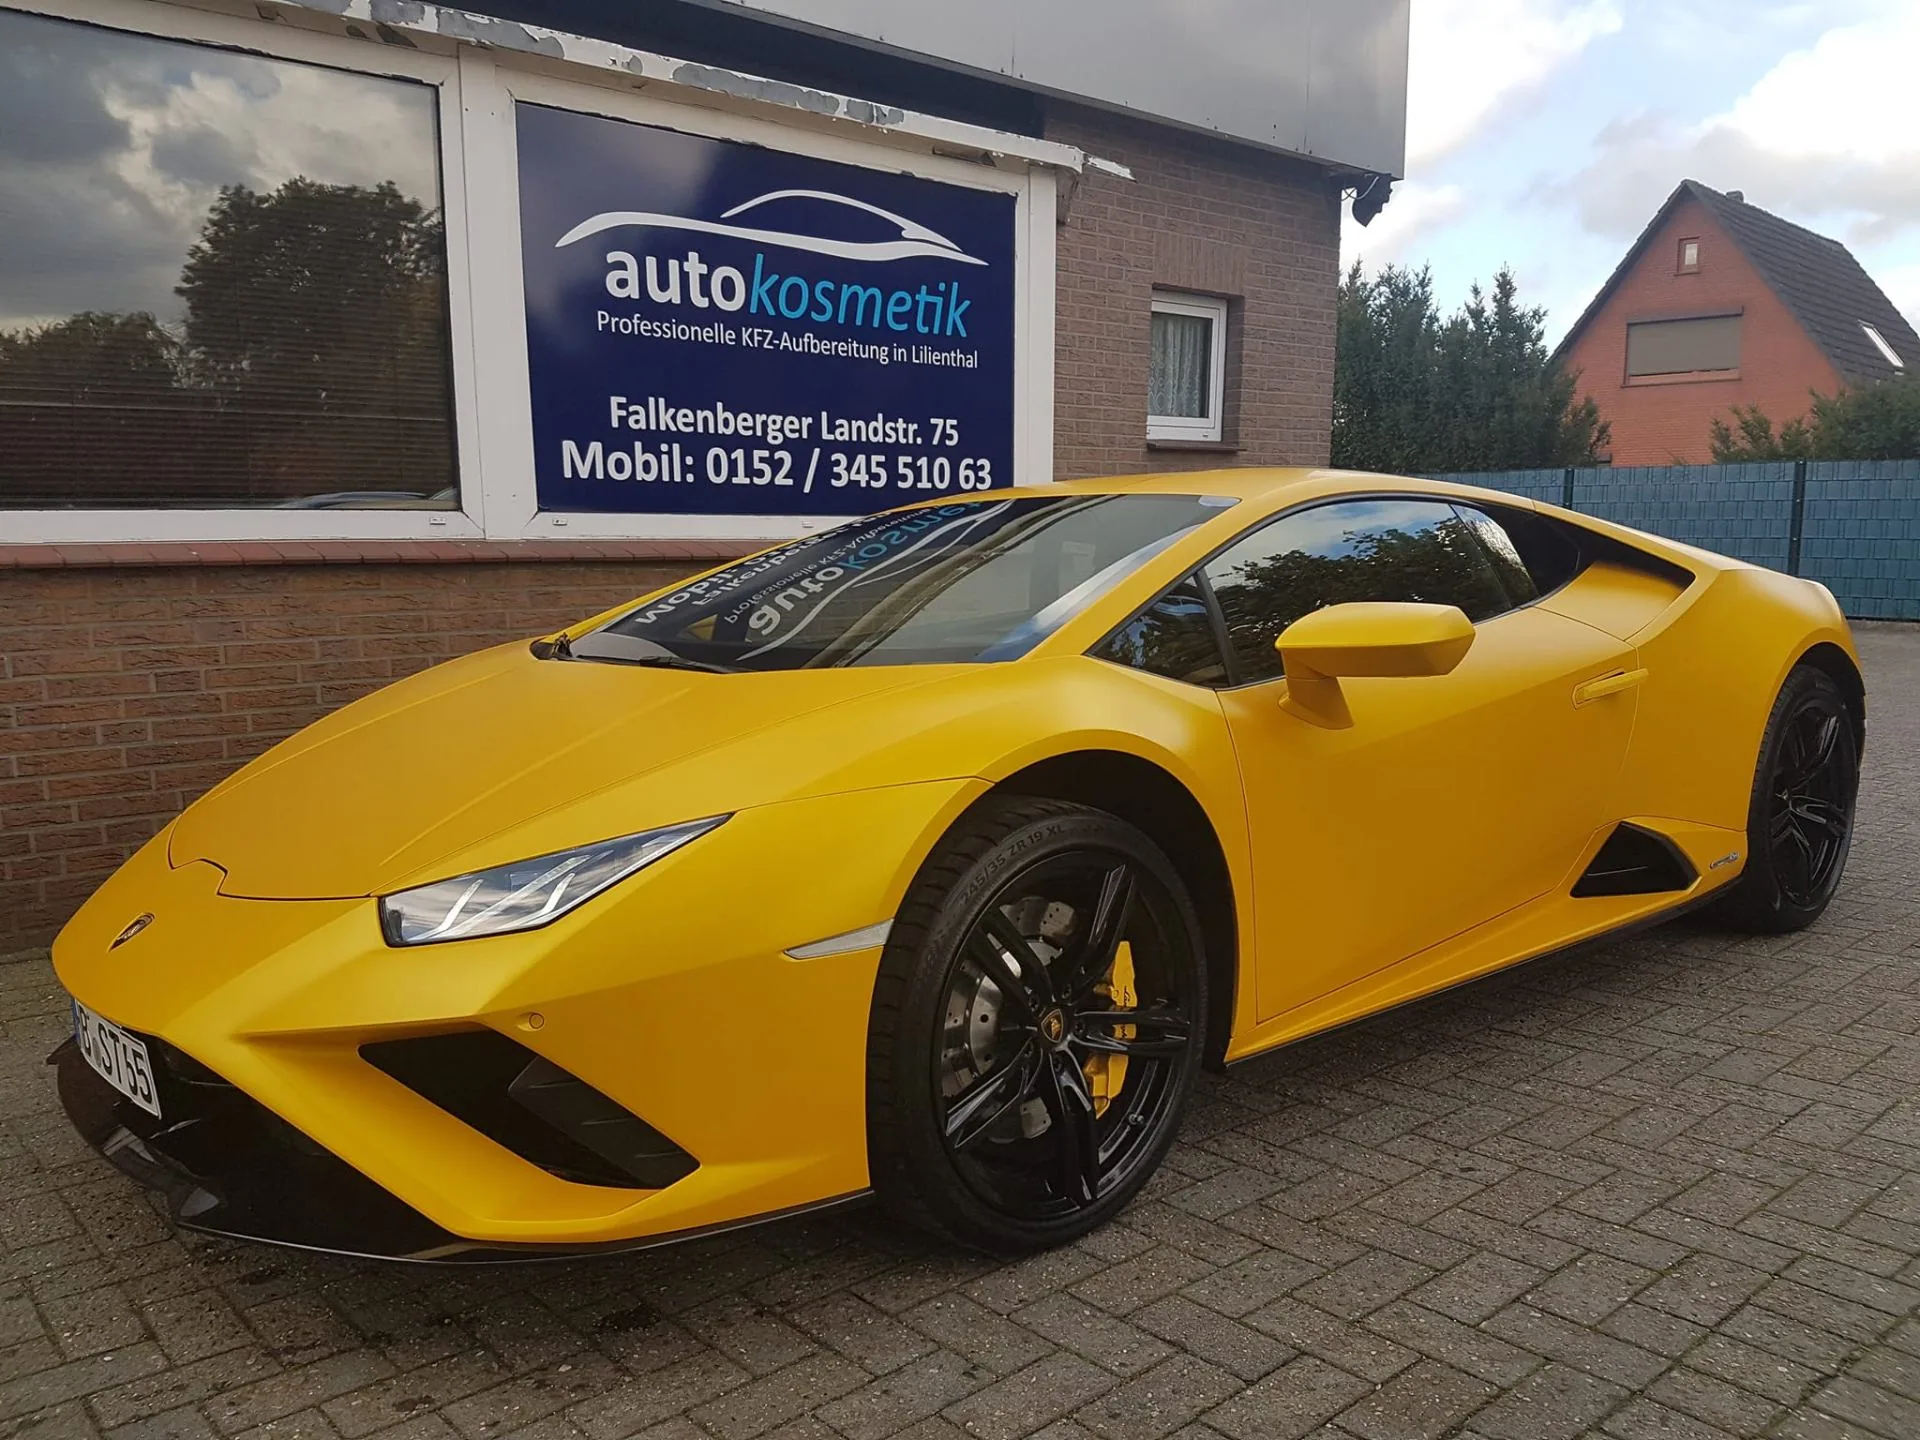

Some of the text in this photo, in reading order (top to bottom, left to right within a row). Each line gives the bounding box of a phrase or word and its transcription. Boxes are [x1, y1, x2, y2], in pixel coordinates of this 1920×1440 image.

[605, 249, 971, 338] autokosmetik
[597, 310, 978, 369] Professionelle KFZ-Aufbereitung in Lilienthal
[610, 396, 959, 446] Falkenberger Landstr. 75
[561, 440, 992, 494] Mobil: 0152 / 345 510 63
